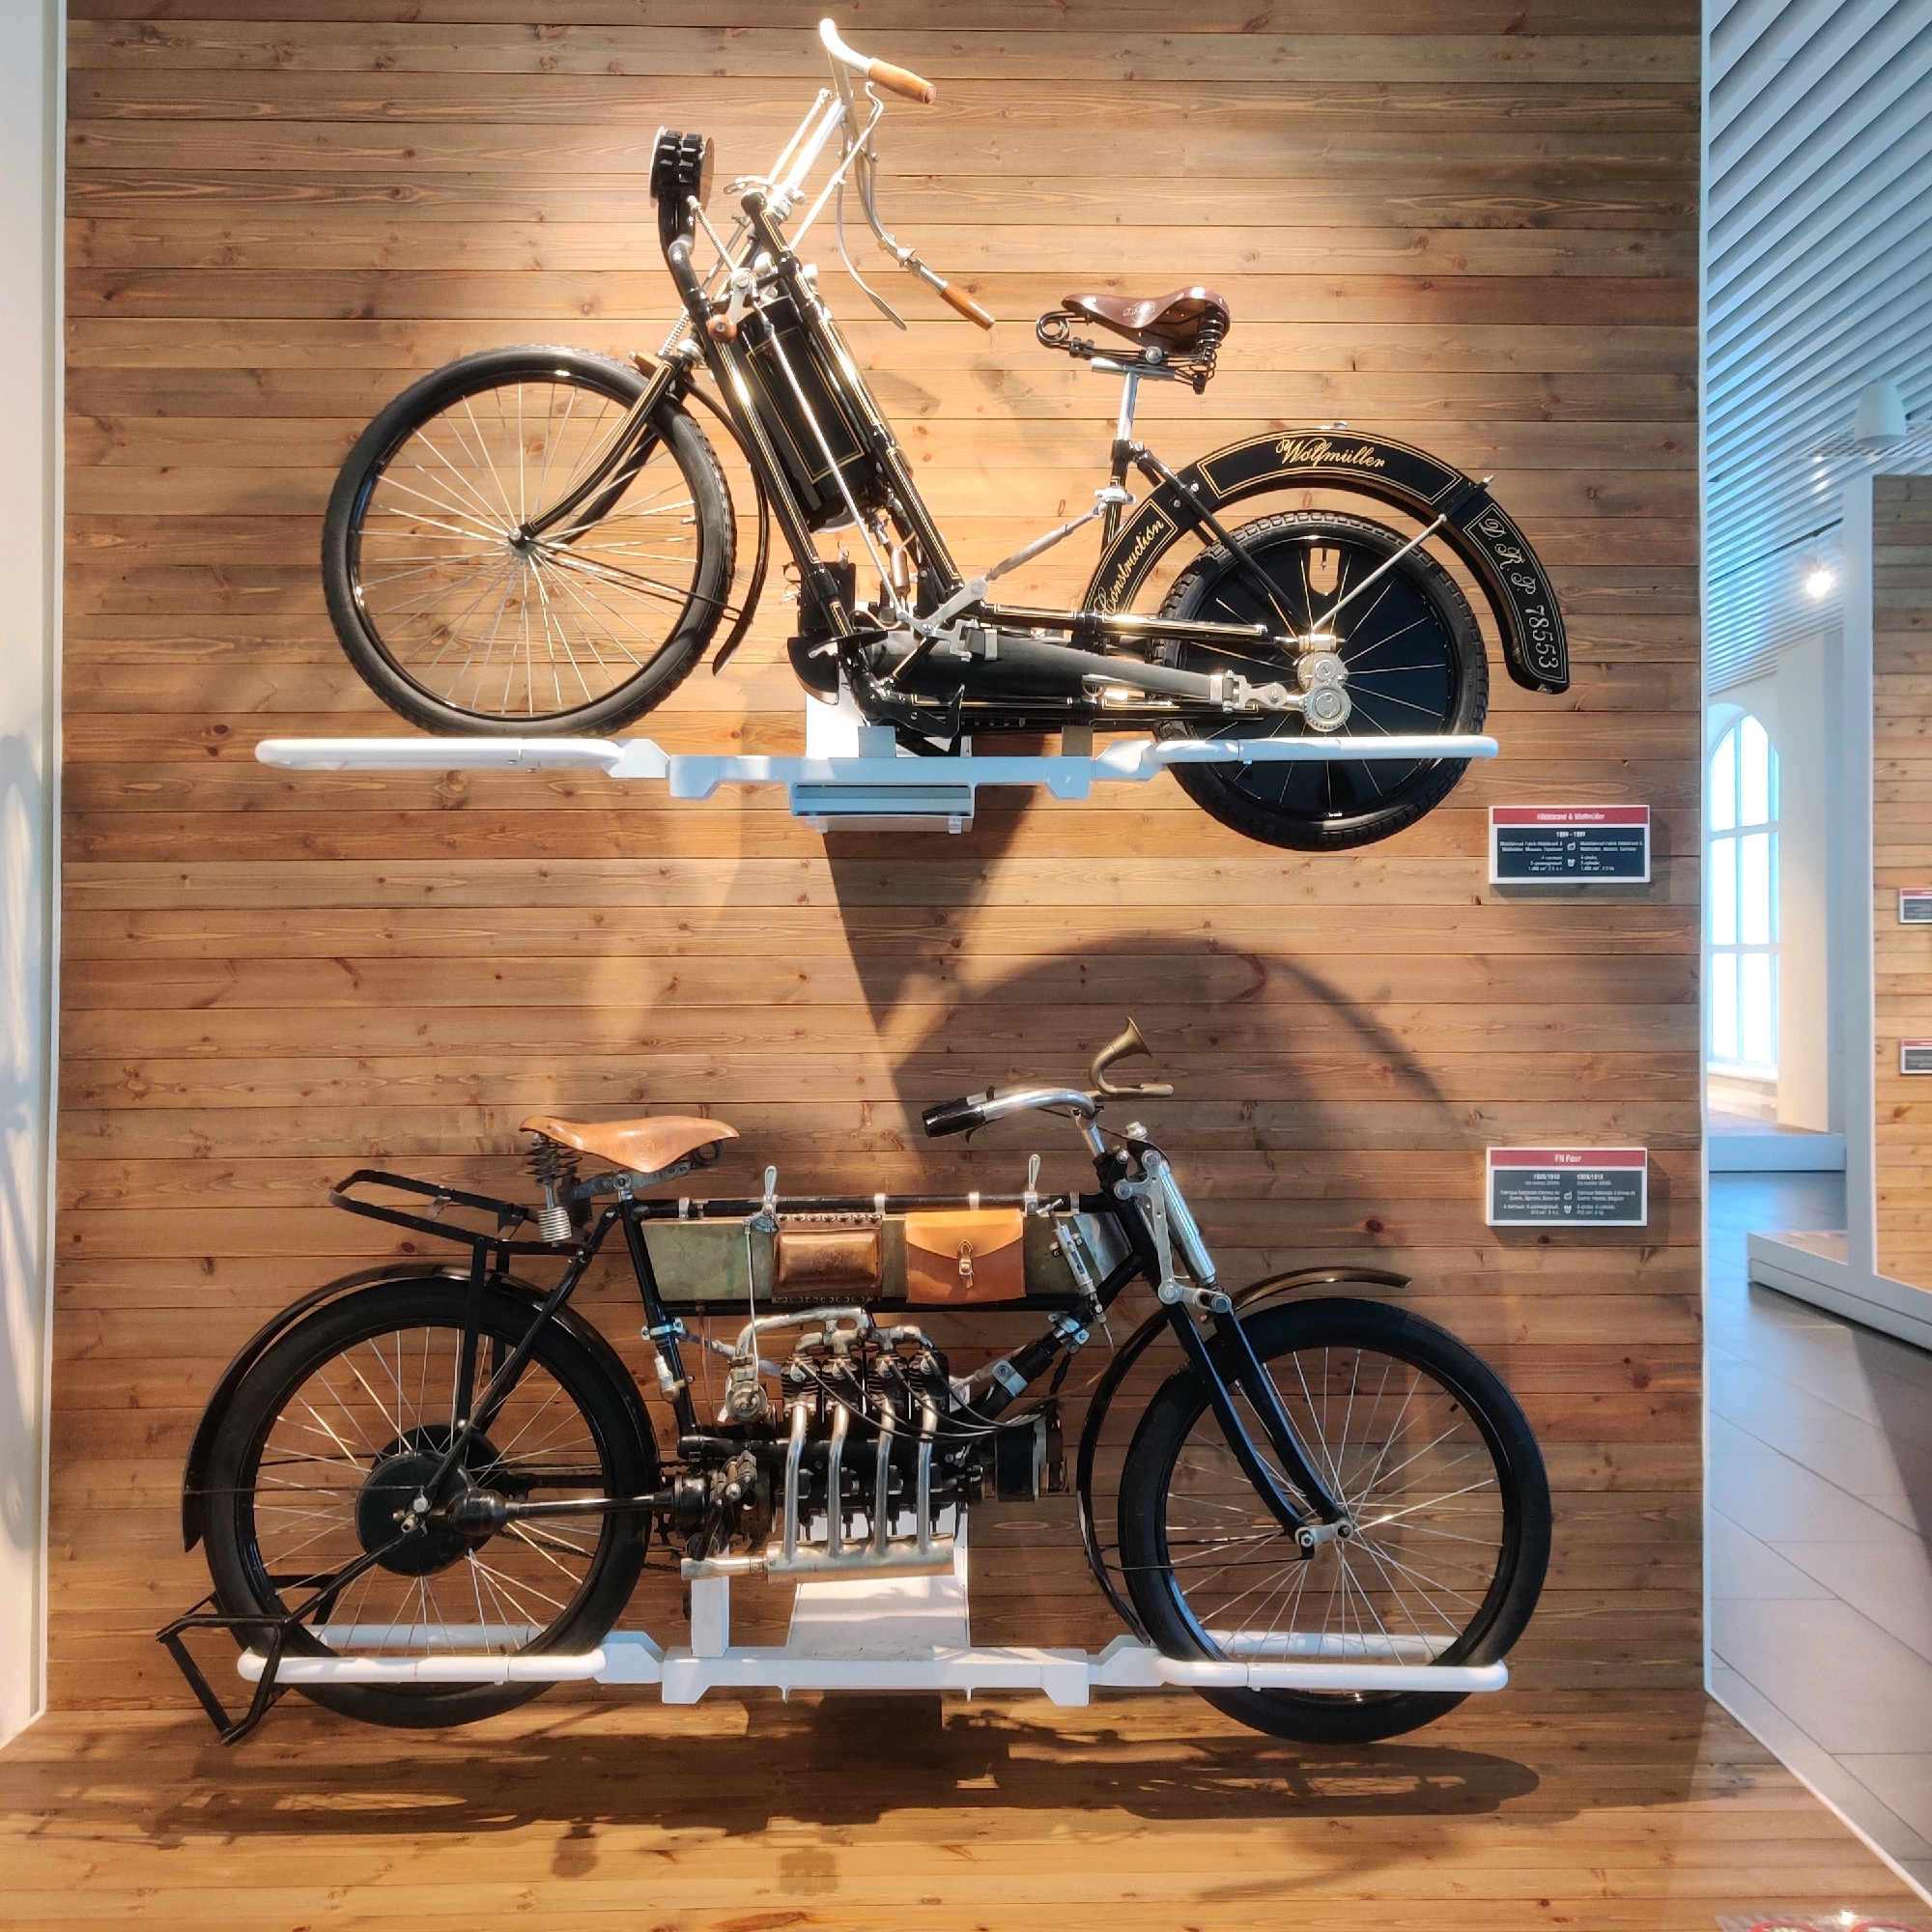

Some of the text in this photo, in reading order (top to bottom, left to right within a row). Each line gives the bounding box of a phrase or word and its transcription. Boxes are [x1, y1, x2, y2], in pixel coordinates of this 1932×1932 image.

[1094, 520, 1165, 615] Construction
[1524, 604, 1559, 668] 78553
[1554, 1154, 1581, 1163] FN Four
